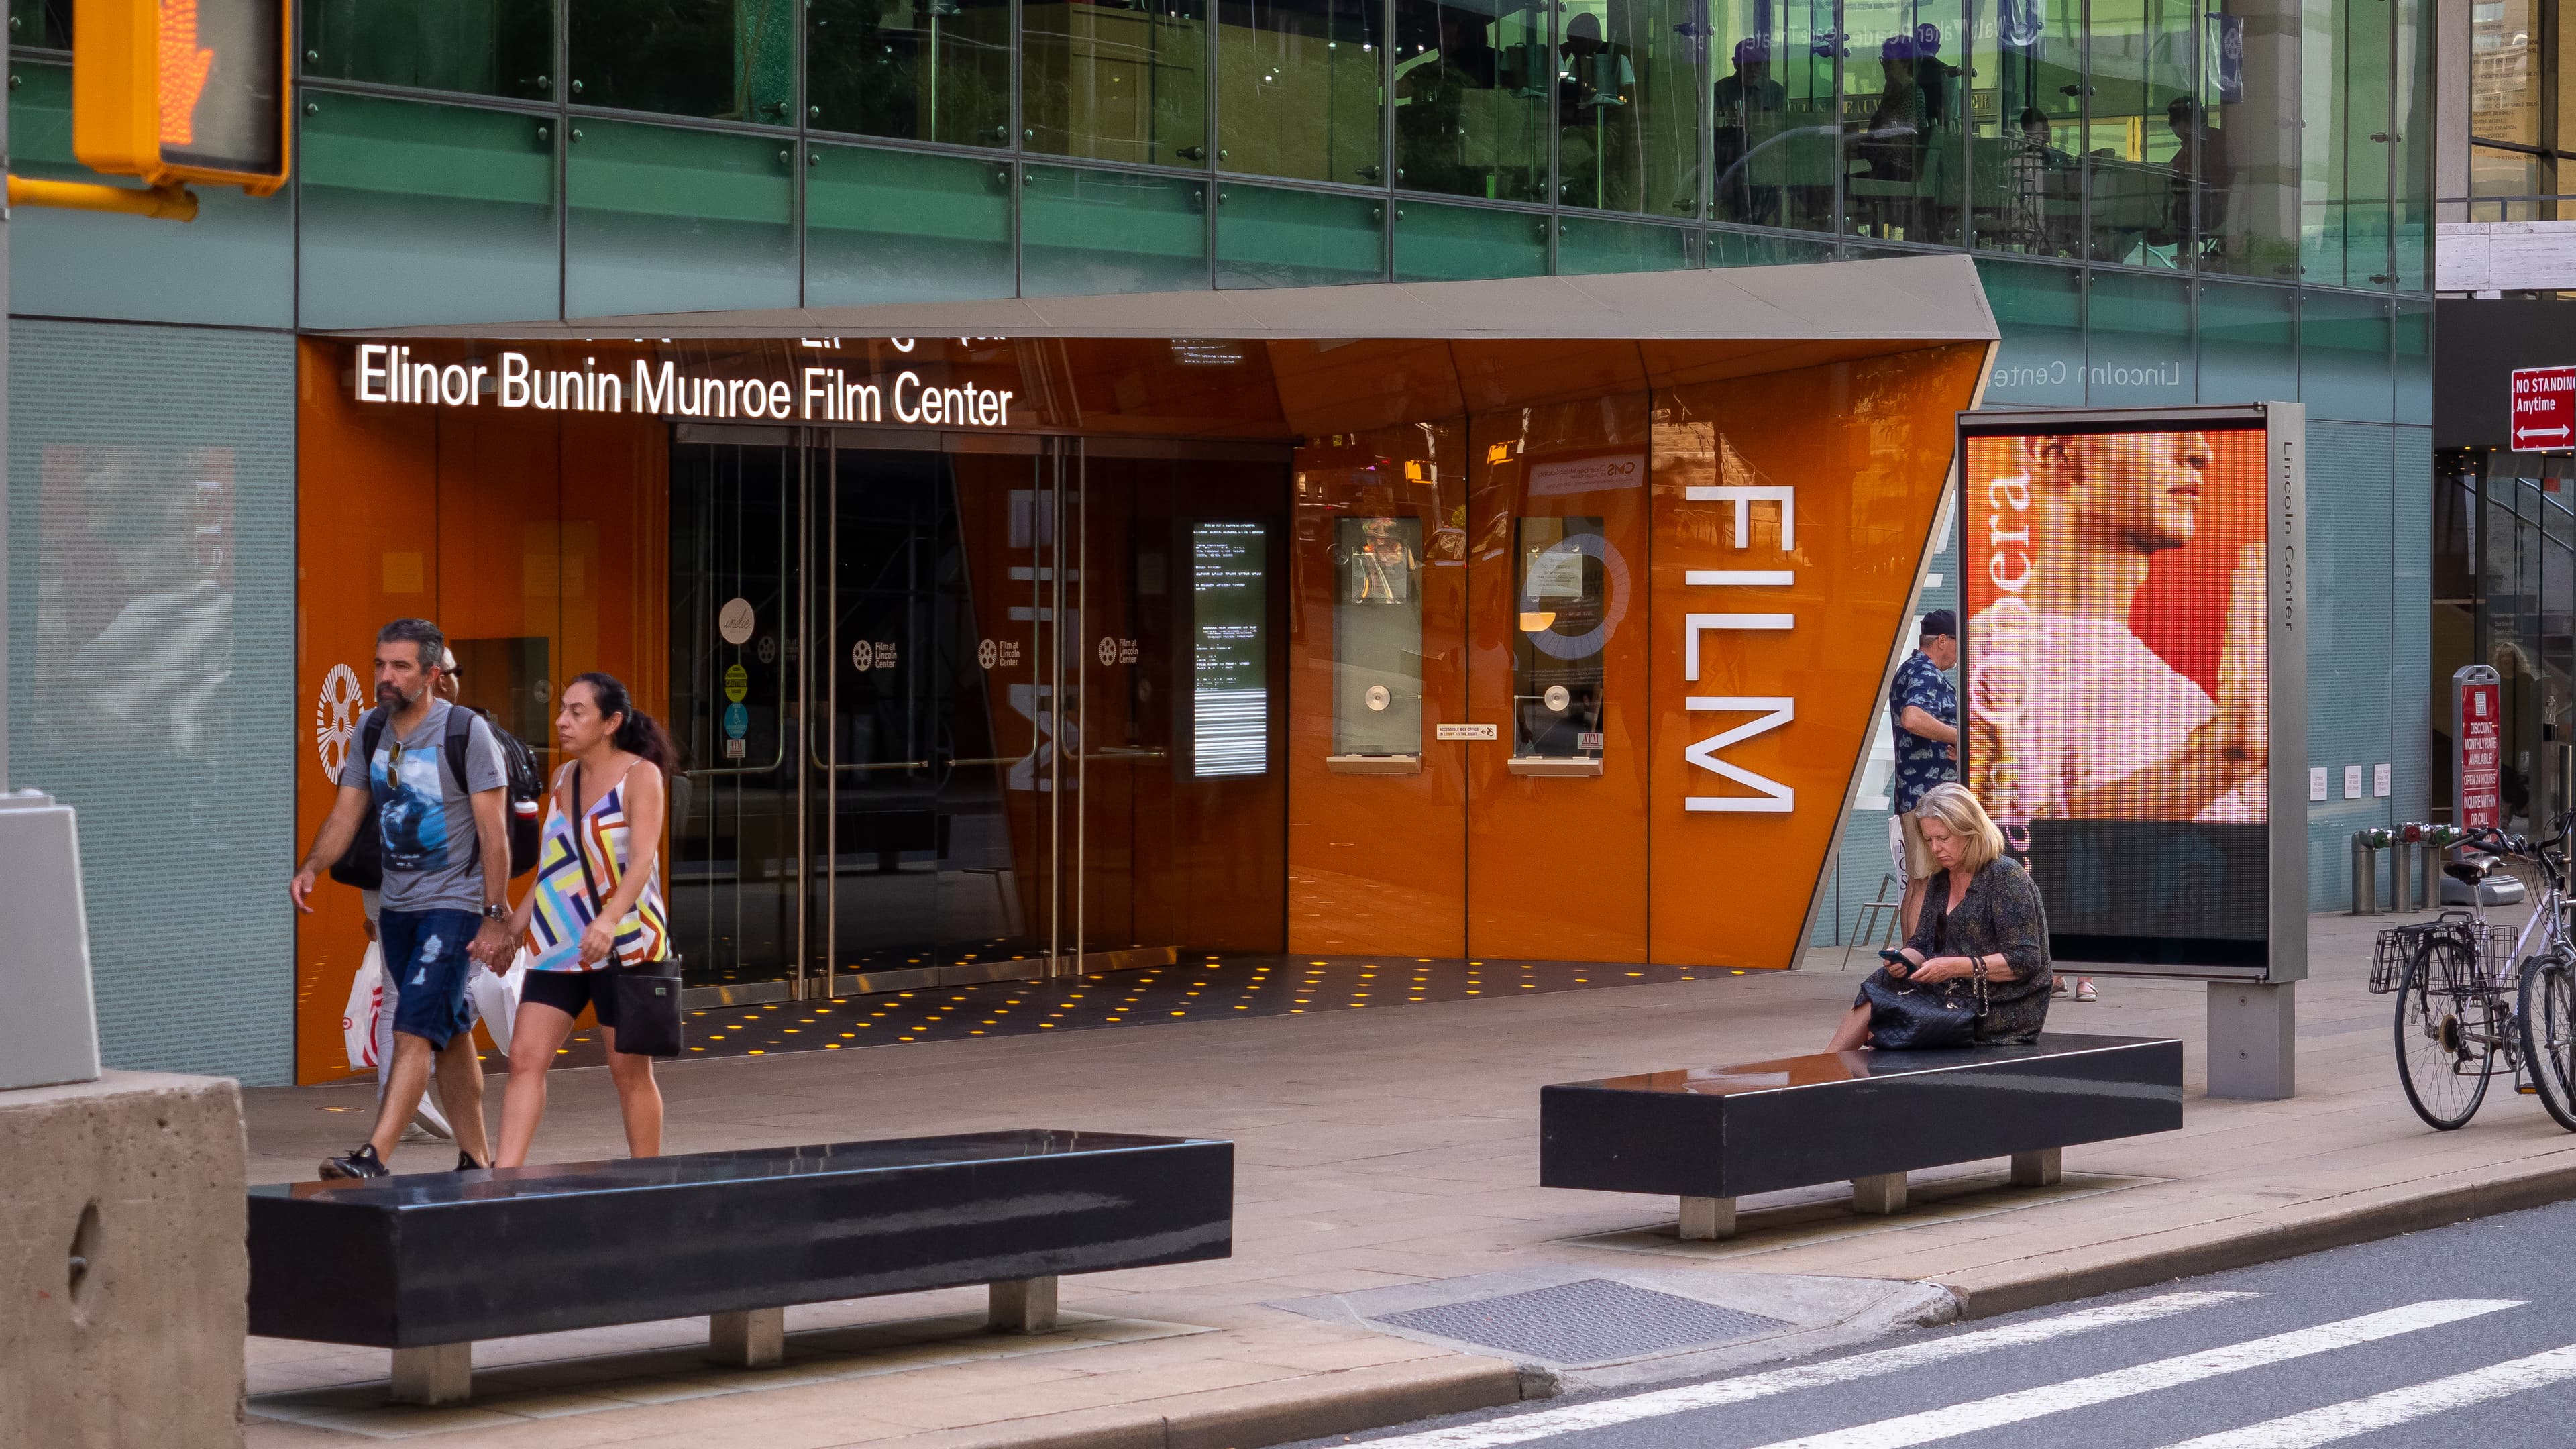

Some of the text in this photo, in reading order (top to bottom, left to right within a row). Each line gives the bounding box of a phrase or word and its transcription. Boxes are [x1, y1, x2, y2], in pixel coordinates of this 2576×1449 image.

[356, 344, 1012, 425] Elinor Bunin Munroe Film Center
[2516, 378, 2530, 394] NO
[2516, 396, 2556, 415] Anytime
[2284, 441, 2294, 631] Lincoln Center
[1968, 470, 2045, 727] Opera
[875, 642, 889, 650] Film
[1000, 641, 1012, 649] Film
[1120, 639, 1131, 647] Film
[1686, 486, 1795, 812] FILM
[875, 650, 897, 659] Lincoln
[1000, 649, 1020, 658] Lincoln
[1120, 647, 1138, 655] Lincoln
[875, 659, 896, 668] Center
[1000, 658, 1018, 667] Center
[1120, 655, 1137, 663] Center
[2470, 722, 2493, 735] DISCOUNT
[2464, 737, 2497, 750] MONTHLY RATE
[2469, 752, 2493, 765] AVAILABLE
[2464, 773, 2496, 785] OPEN 24 HOURS
[2464, 794, 2496, 809] INQUIRE WITHIN
[2471, 812, 2489, 826] OR CALL
